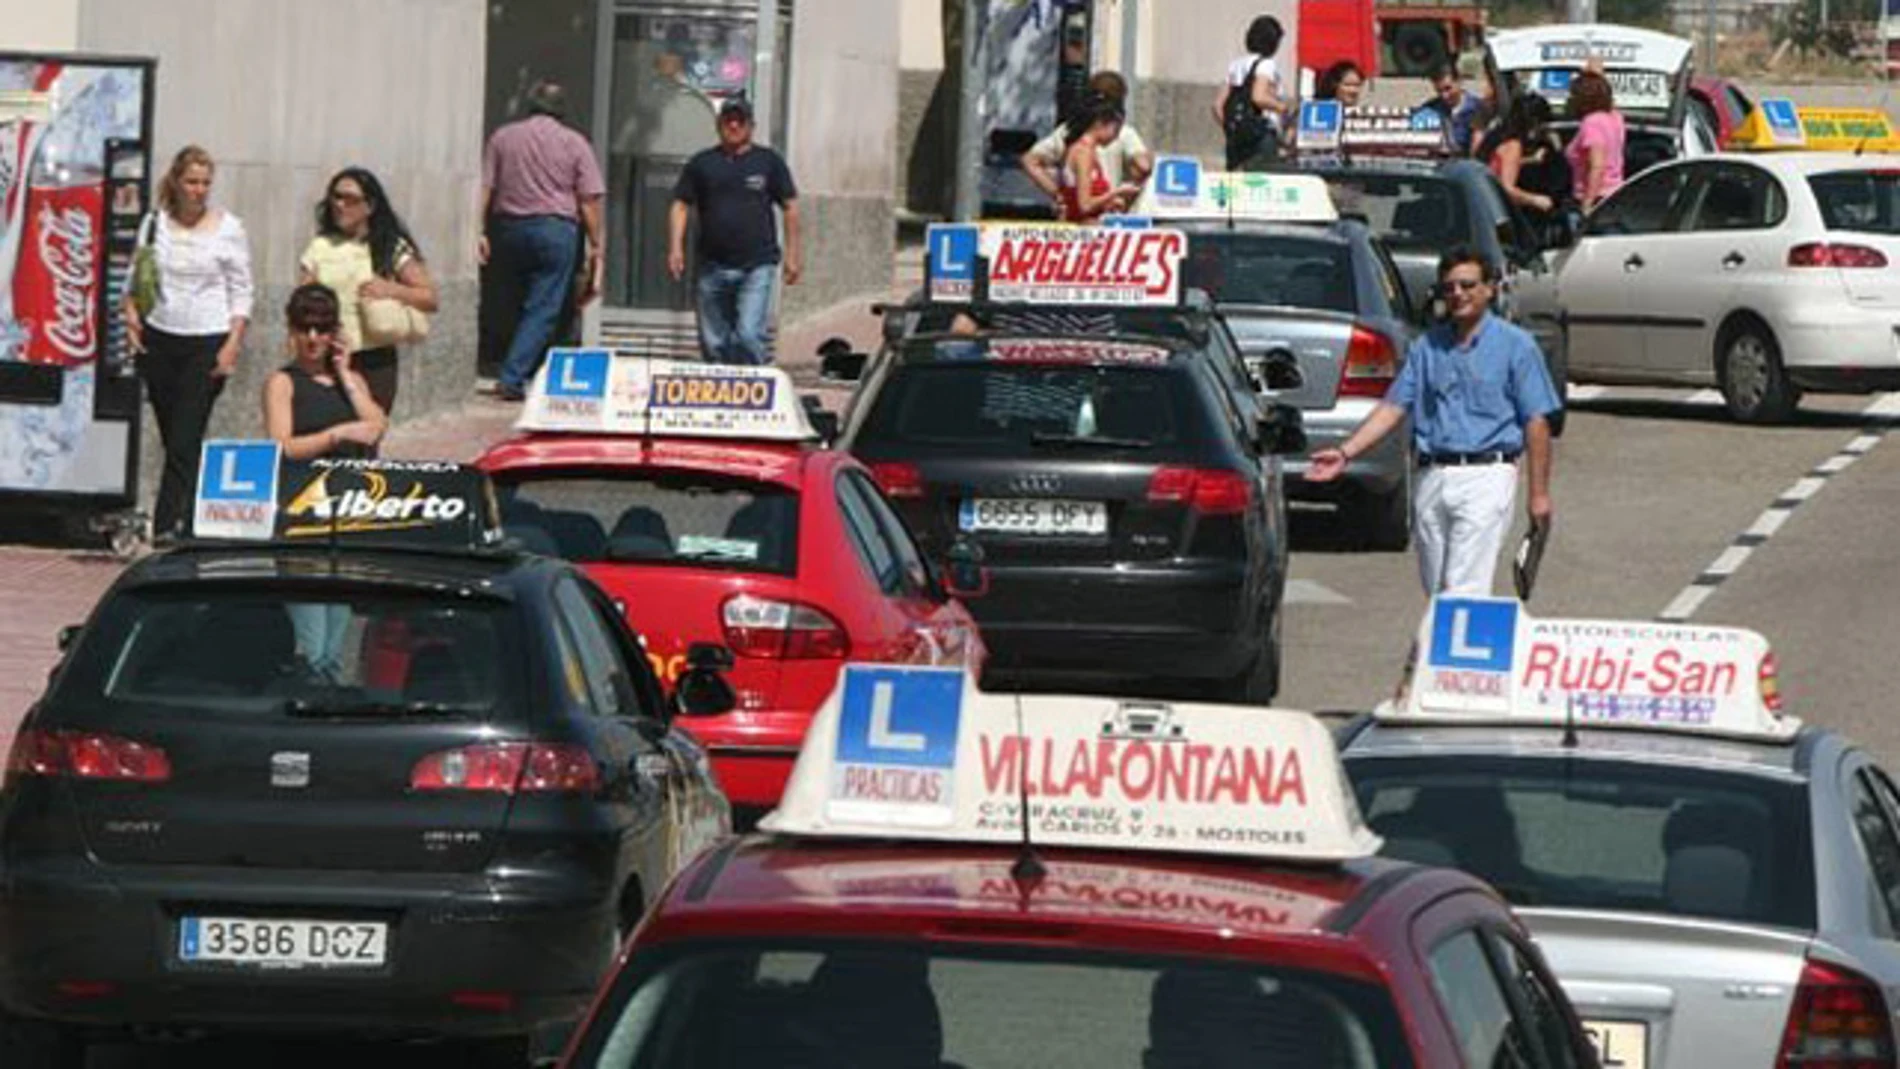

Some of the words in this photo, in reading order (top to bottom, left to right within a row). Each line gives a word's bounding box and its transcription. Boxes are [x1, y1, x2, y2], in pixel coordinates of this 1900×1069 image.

[1310, 106, 1328, 126] L
[1166, 164, 1187, 191] L
[940, 235, 964, 270] L
[561, 357, 588, 390] L
[655, 379, 769, 405] TORRADO
[221, 451, 254, 491] L
[287, 472, 466, 518] Alberto
[1450, 608, 1492, 660] L
[1533, 624, 1741, 643] AUTOESCUELAS
[1522, 643, 1739, 695] Rubi-San
[868, 680, 926, 750] L
[979, 734, 1307, 806] VILLAFONTANA
[978, 803, 1121, 820] C/VRACRUZ,
[1040, 820, 1121, 834] CARLOS
[1196, 828, 1305, 844] MOSTOLES
[207, 922, 295, 955] 3586
[308, 925, 375, 958] DCZ
